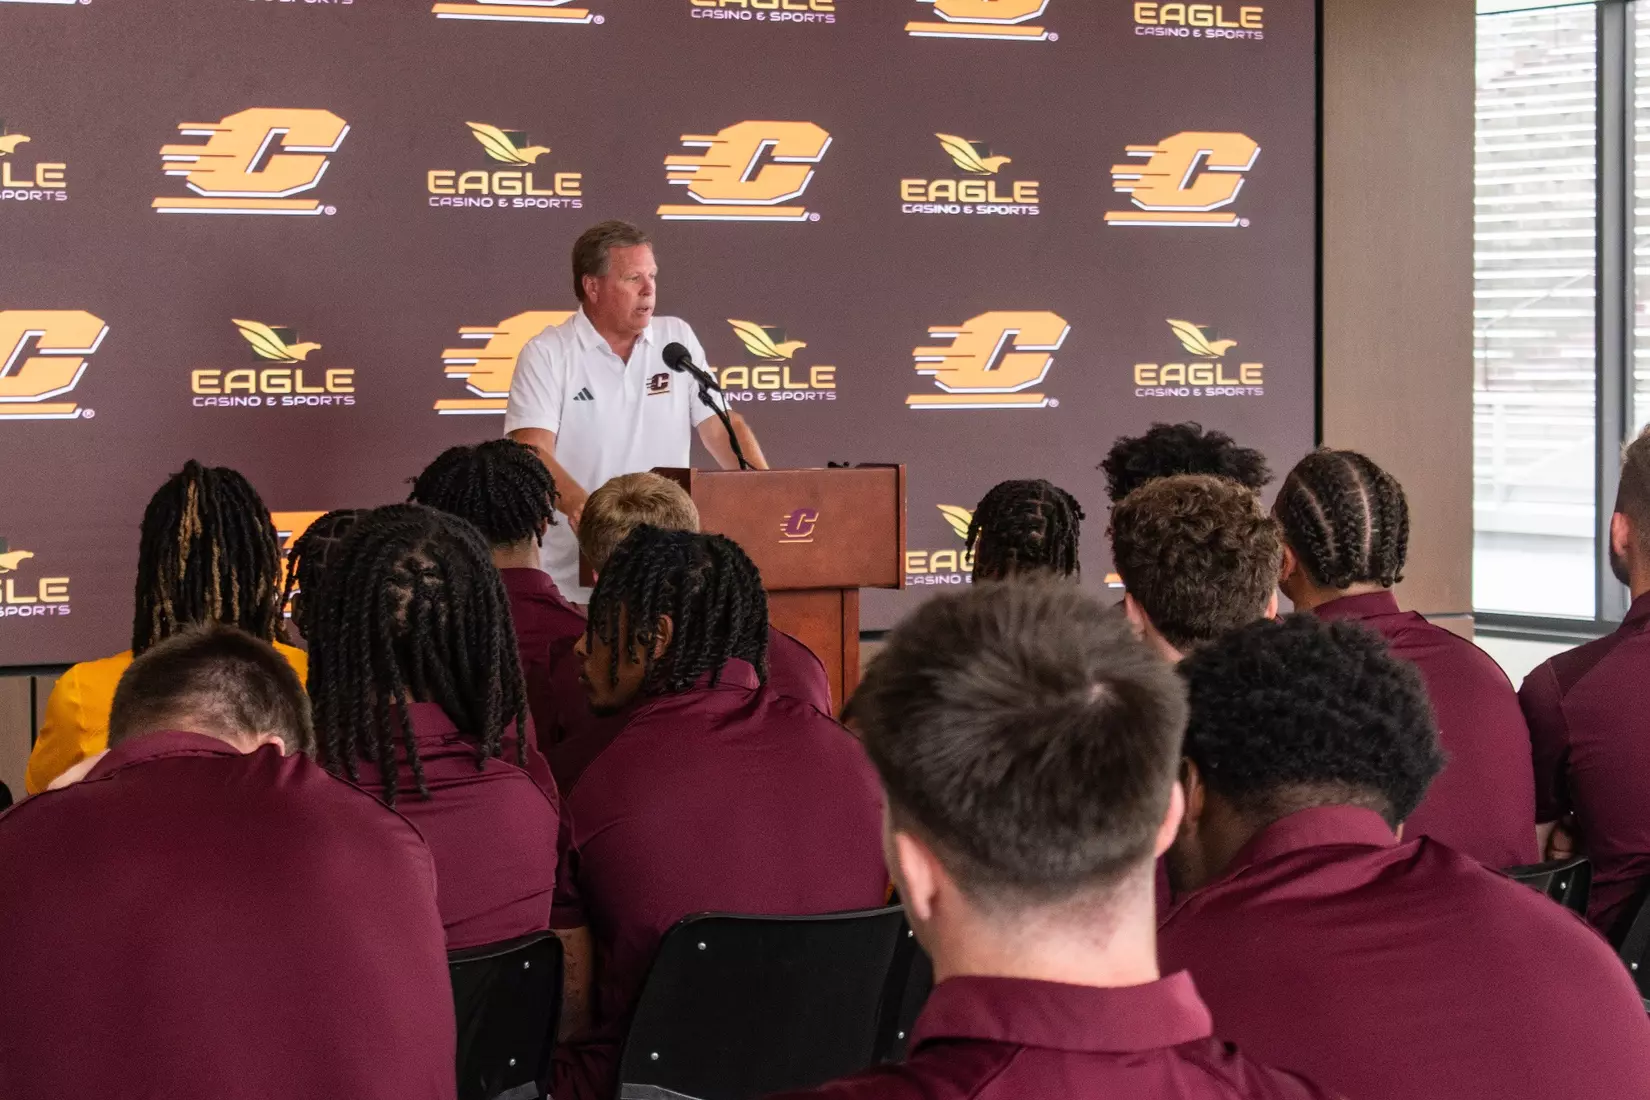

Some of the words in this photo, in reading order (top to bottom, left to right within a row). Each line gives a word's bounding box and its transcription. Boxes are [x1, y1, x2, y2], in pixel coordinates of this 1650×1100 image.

[691, 9, 752, 21] CASINO
[756, 11, 766, 21] &
[769, 11, 836, 24] SPORTS
[1134, 2, 1263, 29] EAGLE
[1134, 26, 1190, 38] CASINO
[1192, 29, 1202, 38] &
[1205, 28, 1264, 40] SPORTS
[427, 170, 583, 197] EAGLE
[0, 189, 68, 201] PORTS
[900, 179, 1040, 204] EAGLE
[428, 196, 494, 208] CASINO
[498, 198, 508, 208] &
[512, 197, 583, 209] SPORTS
[902, 203, 961, 215] CASINO
[963, 205, 974, 215] &
[976, 204, 1040, 216] SPORTS
[191, 368, 355, 395] EAGLE
[710, 365, 837, 390] AGLE
[1134, 363, 1264, 386] EAGLE
[724, 391, 753, 402] INO
[757, 391, 767, 402] &
[771, 391, 837, 401] SPORTS
[1134, 387, 1190, 397] CASINO
[1192, 388, 1202, 397] &
[1205, 387, 1264, 397] SPORTS
[192, 396, 262, 407] CASINO
[266, 397, 278, 407] &
[281, 395, 356, 406] SPORTS
[905, 574, 962, 586] CASINO
